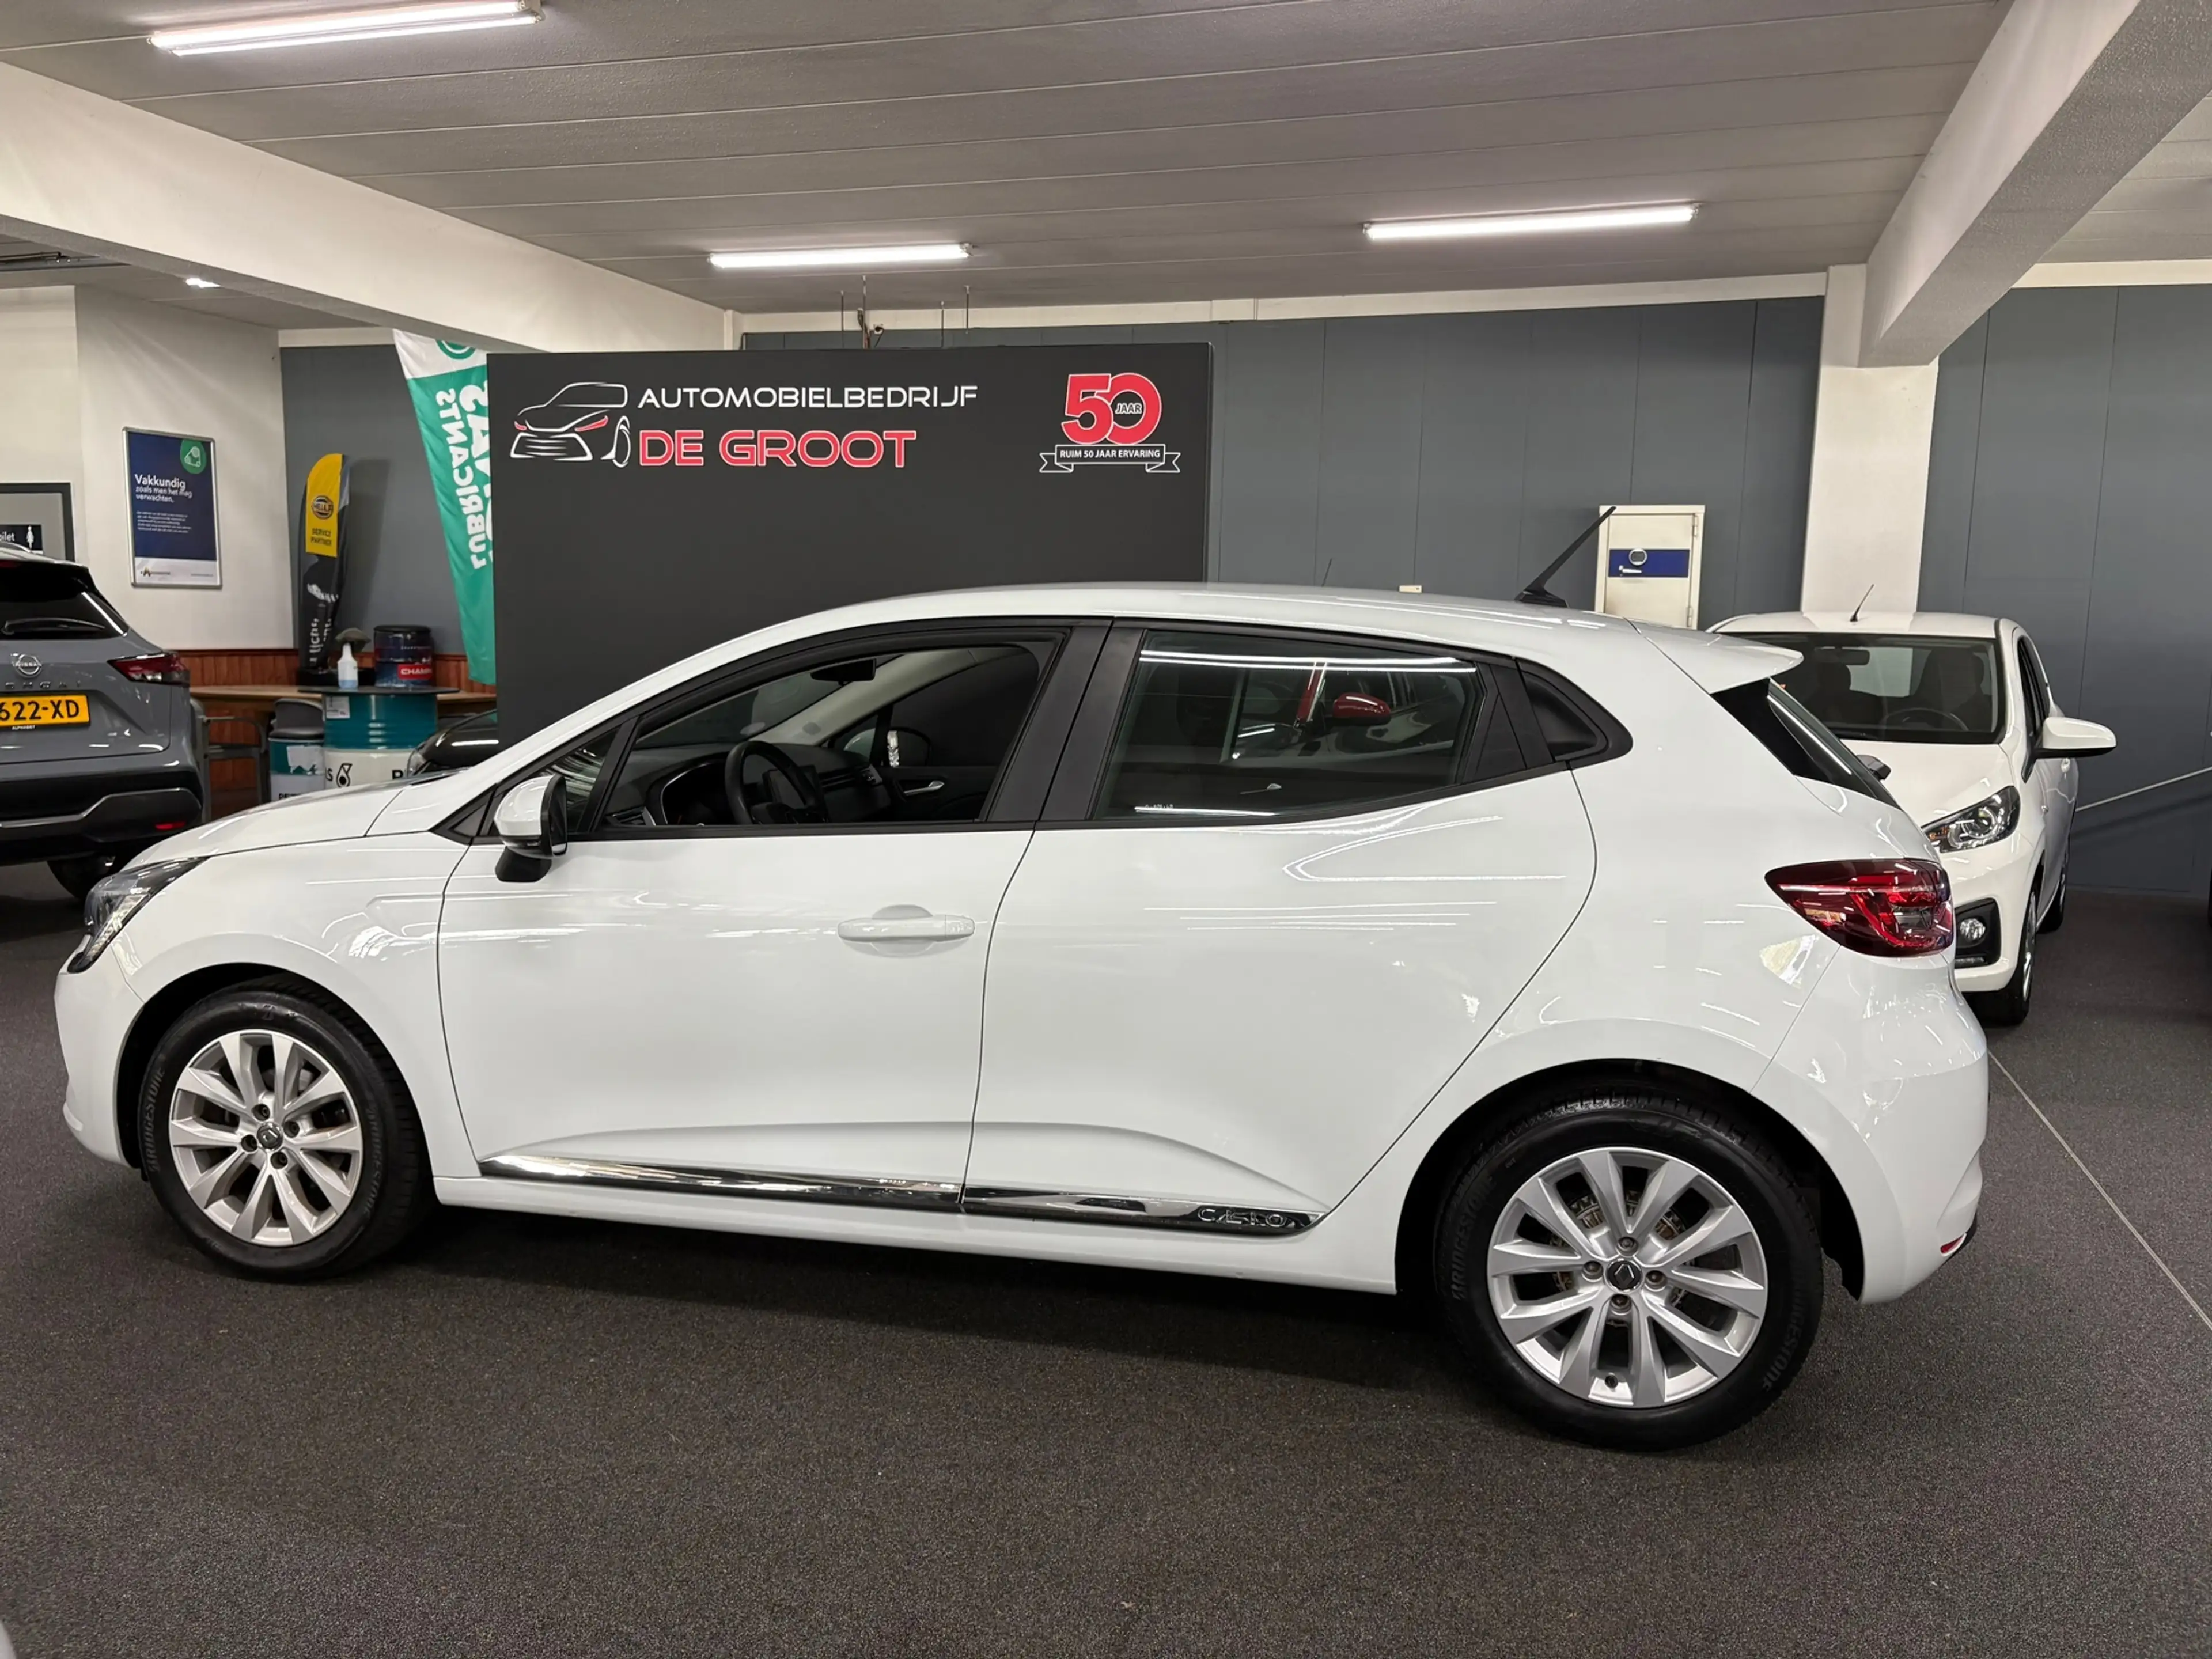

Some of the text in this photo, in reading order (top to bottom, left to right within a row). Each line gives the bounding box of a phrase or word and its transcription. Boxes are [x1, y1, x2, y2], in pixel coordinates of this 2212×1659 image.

[638, 386, 978, 408] AUTOMOBIELBEDRIJF
[1062, 373, 1162, 445] 50
[1115, 403, 1142, 414] JAAR
[639, 430, 916, 468] DE GROOT
[1060, 449, 1082, 459] RUIM
[1119, 450, 1160, 458] ERVARING
[135, 474, 185, 491] Vakkundig
[136, 494, 175, 503] verwachten.
[1198, 1208, 1286, 1228] CLIO
